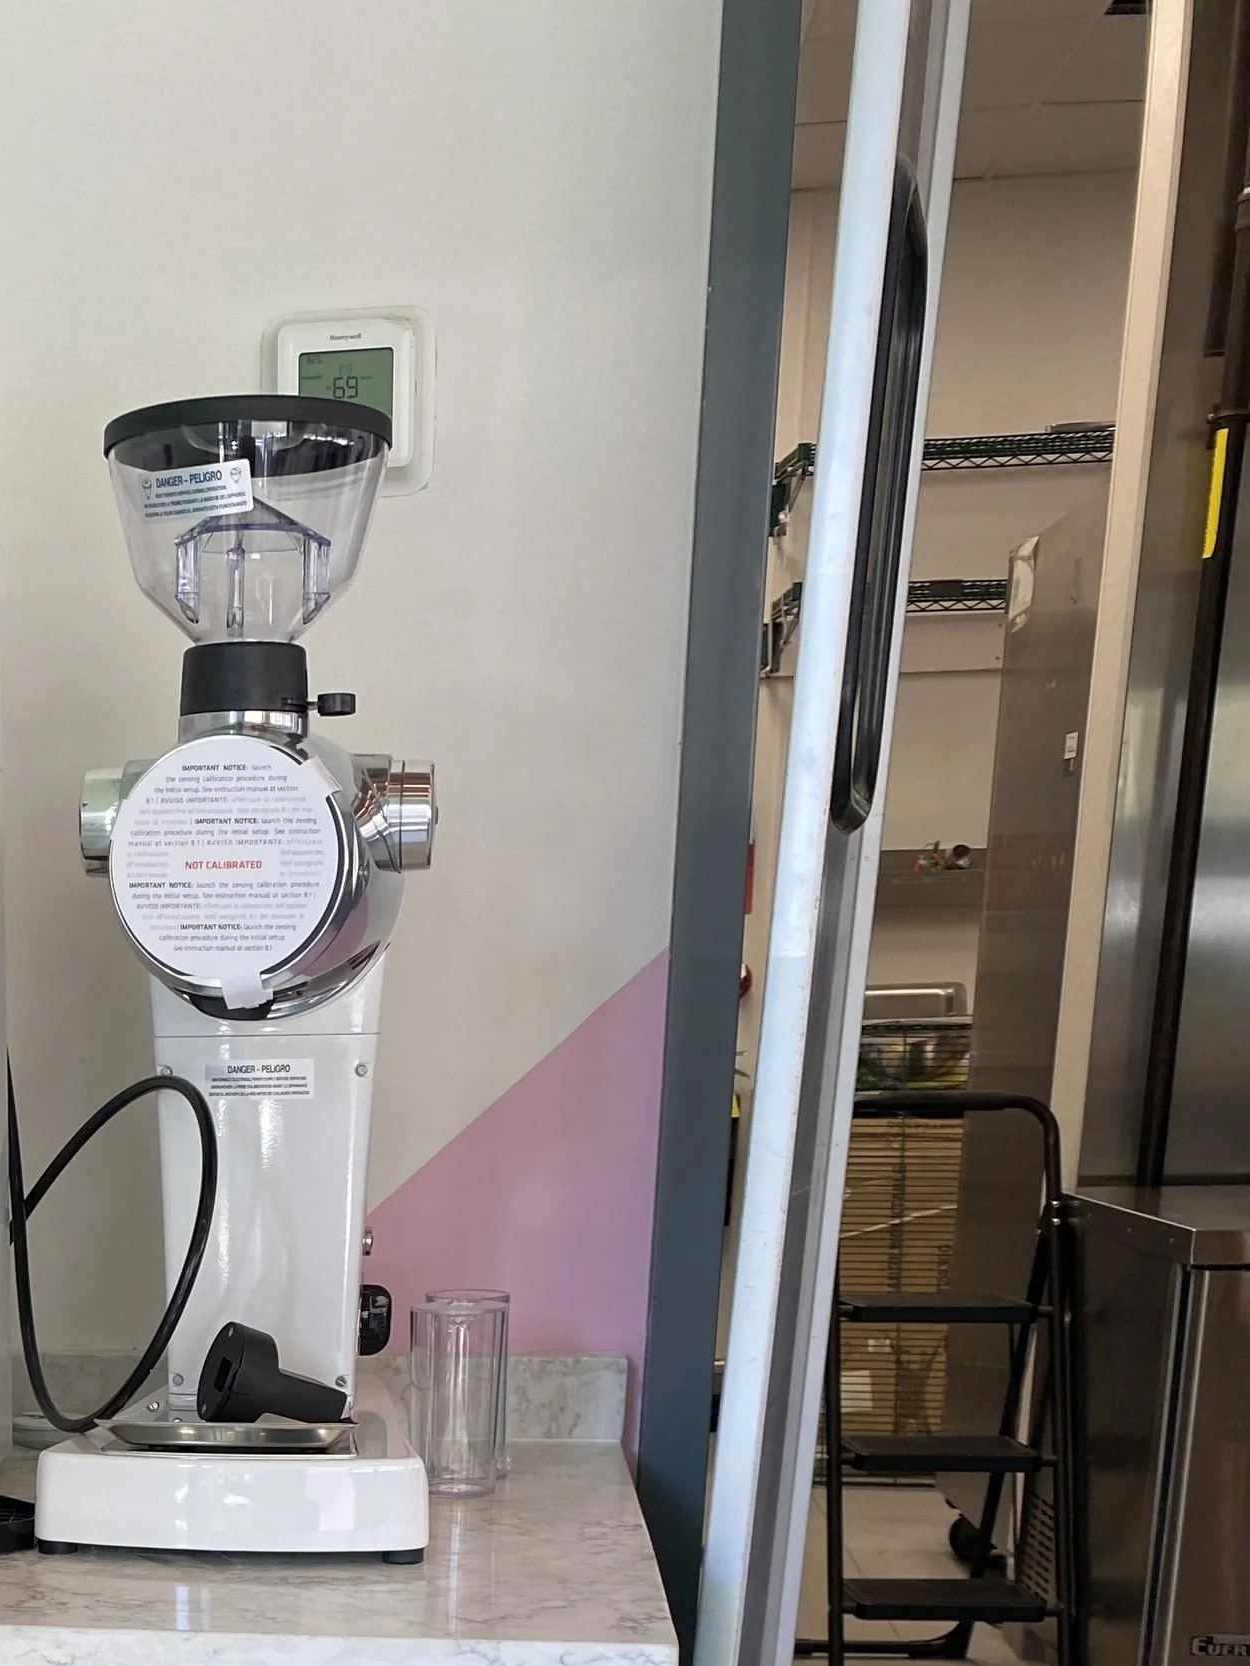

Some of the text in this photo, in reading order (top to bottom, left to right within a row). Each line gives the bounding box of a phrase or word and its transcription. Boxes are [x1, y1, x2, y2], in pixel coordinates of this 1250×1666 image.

[333, 376, 358, 399] 69
[155, 470, 223, 488] DANGER PELIGRO
[185, 860, 262, 870] NOT CALIBRATED
[290, 881, 320, 889] procedure
[227, 1064, 291, 1074] DANGER PELIGRO
